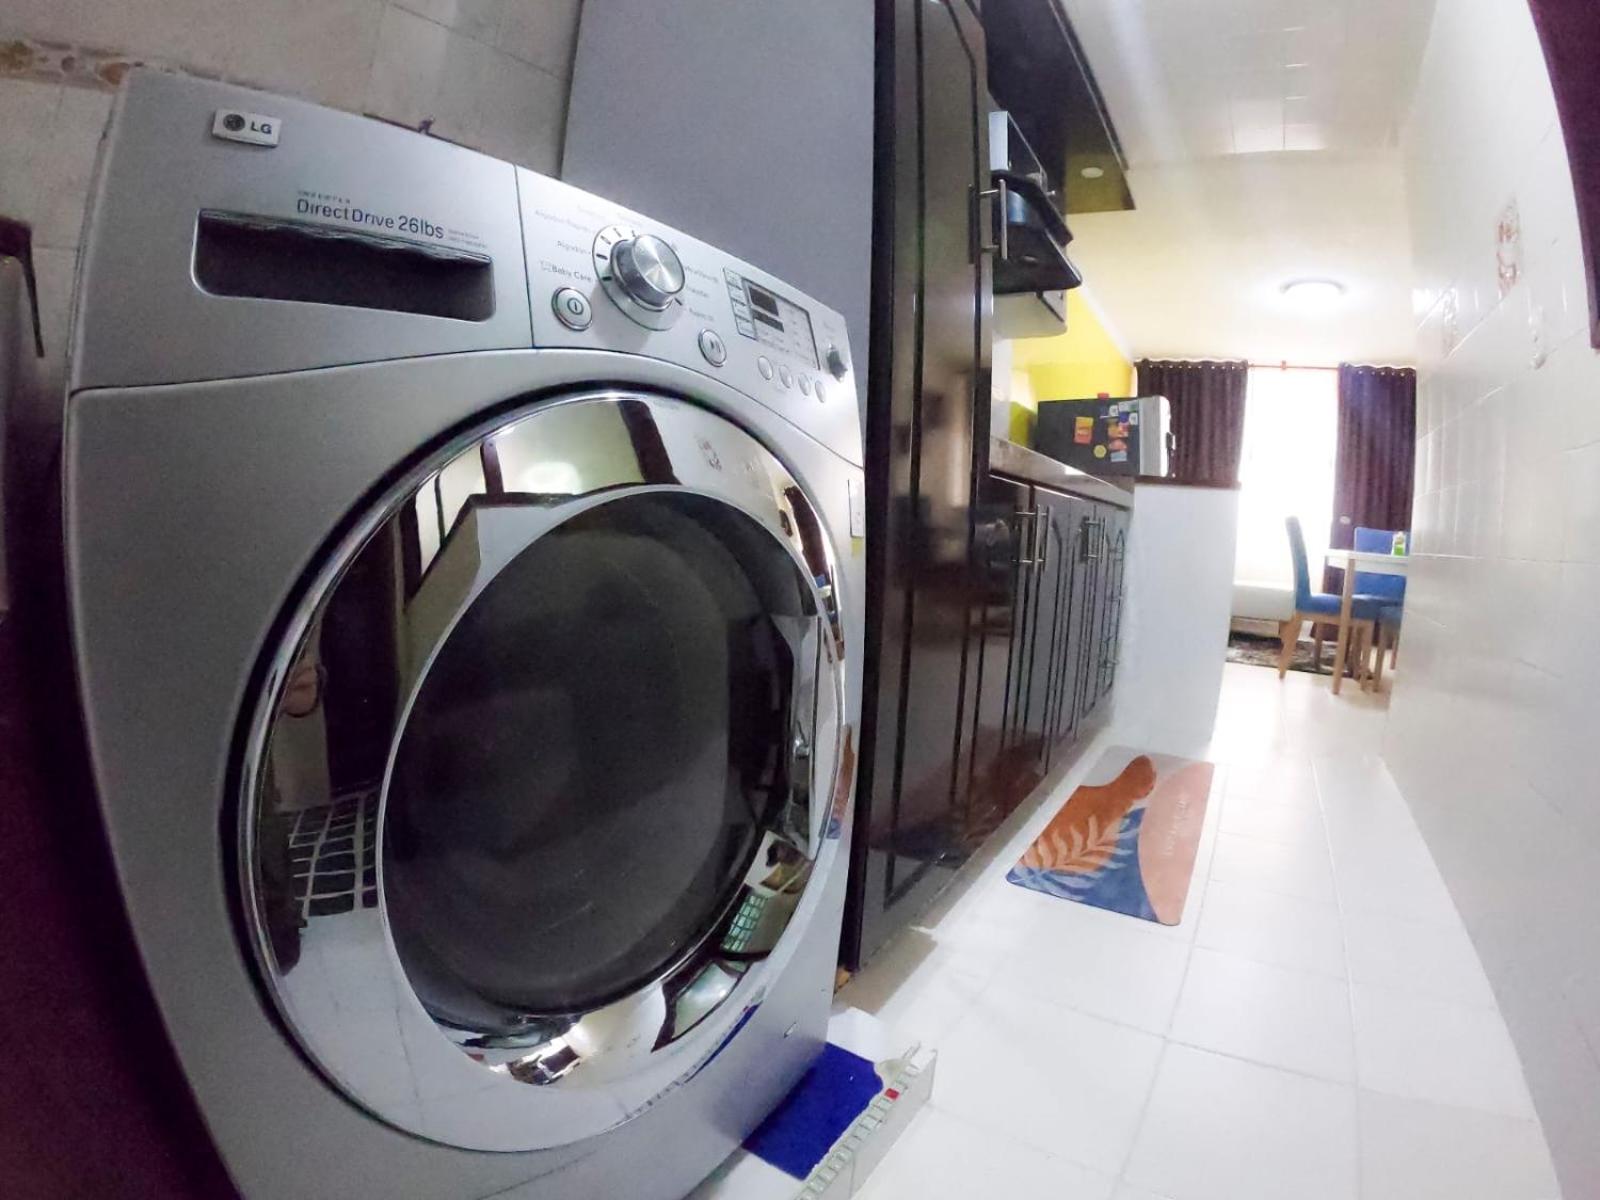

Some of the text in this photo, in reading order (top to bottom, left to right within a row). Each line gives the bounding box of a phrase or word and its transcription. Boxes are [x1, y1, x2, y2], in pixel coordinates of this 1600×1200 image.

[250, 120, 272, 135] LG
[297, 198, 349, 221] Direct
[351, 208, 395, 229] Drive
[398, 215, 444, 240] 26lbs
[573, 270, 592, 282] Care
